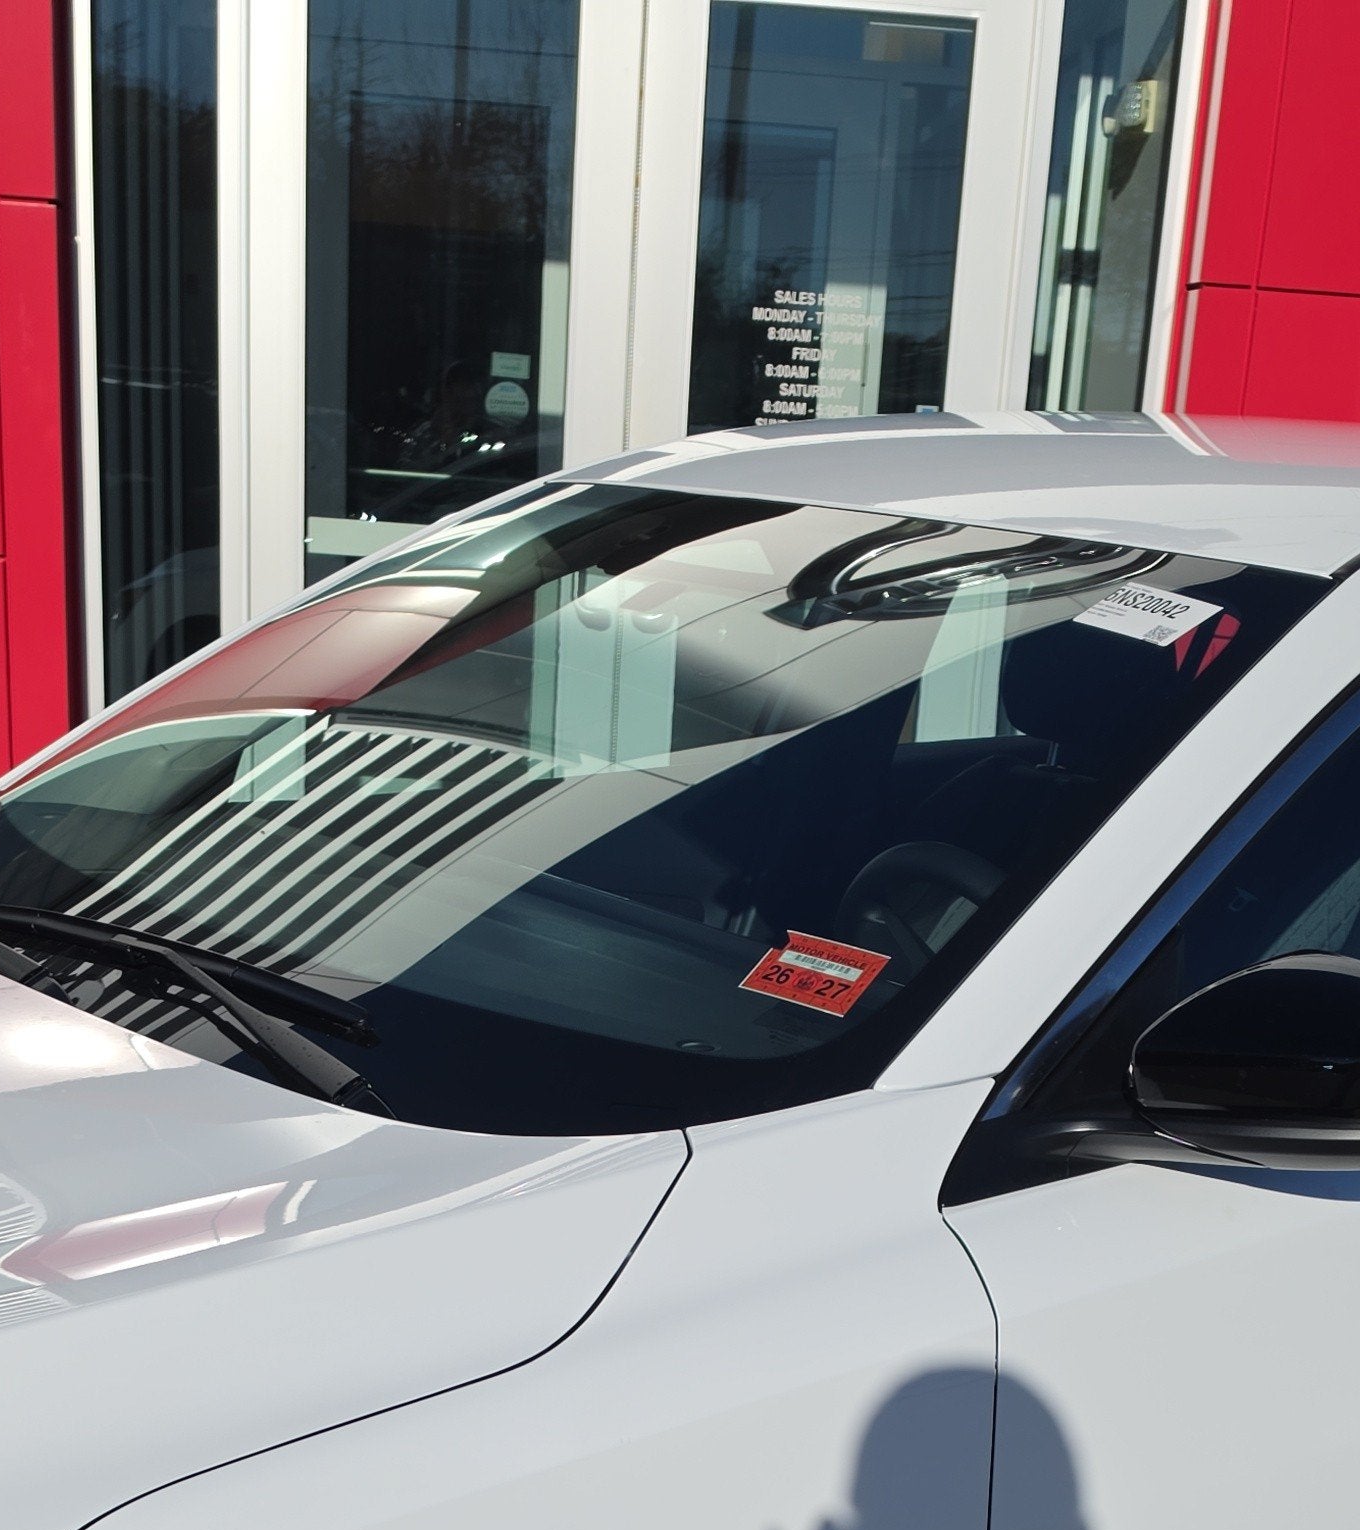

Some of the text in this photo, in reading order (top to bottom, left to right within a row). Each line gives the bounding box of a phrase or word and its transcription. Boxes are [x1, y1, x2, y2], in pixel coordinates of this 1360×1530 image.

[774, 290, 863, 308] SALES HOURS
[752, 307, 807, 323] MONDAY
[816, 311, 883, 327] THURSDAY
[767, 327, 812, 342] 8:00AM
[791, 347, 837, 362] FRIDAY
[764, 363, 810, 379] 8:00AM
[779, 383, 845, 398] SATURDAY
[762, 400, 807, 415] 8:00AM
[790, 943, 824, 959] MOTOR
[825, 951, 868, 968] VEHICLE
[761, 964, 851, 999] 26 27
